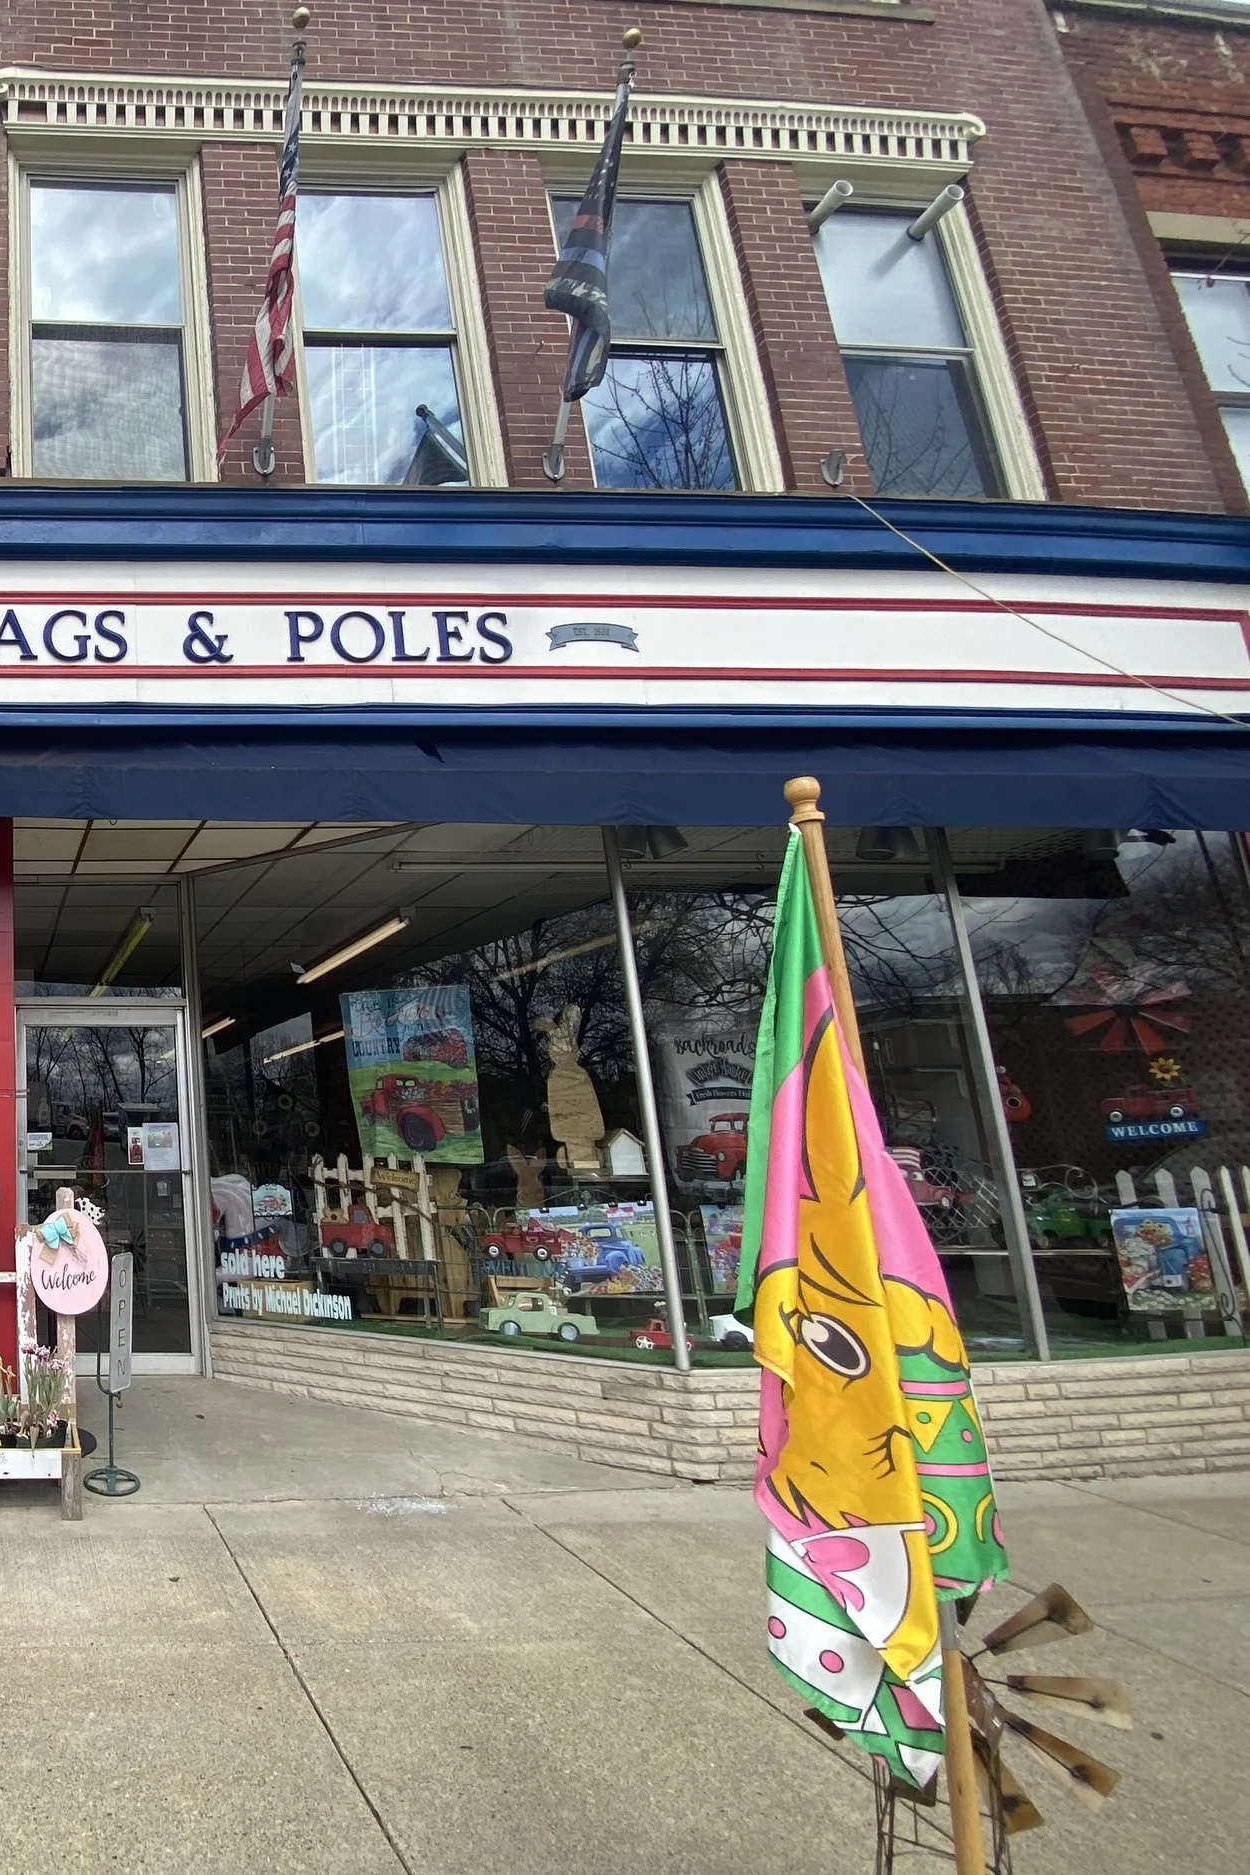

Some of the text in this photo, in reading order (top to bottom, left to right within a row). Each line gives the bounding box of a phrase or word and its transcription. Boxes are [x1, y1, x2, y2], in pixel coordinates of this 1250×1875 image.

[183, 611, 233, 663] &
[284, 611, 513, 664] POLES
[351, 1036, 401, 1057] COUNTRY
[673, 1031, 756, 1060] Backroads
[1110, 1121, 1199, 1138] WELCOME
[376, 1171, 416, 1185] Welcome
[41, 1263, 96, 1291] Welcome
[220, 1248, 285, 1279] sold here
[222, 1282, 352, 1320] Prints by Michael Dickinson
[117, 1269, 127, 1377] OPEN
